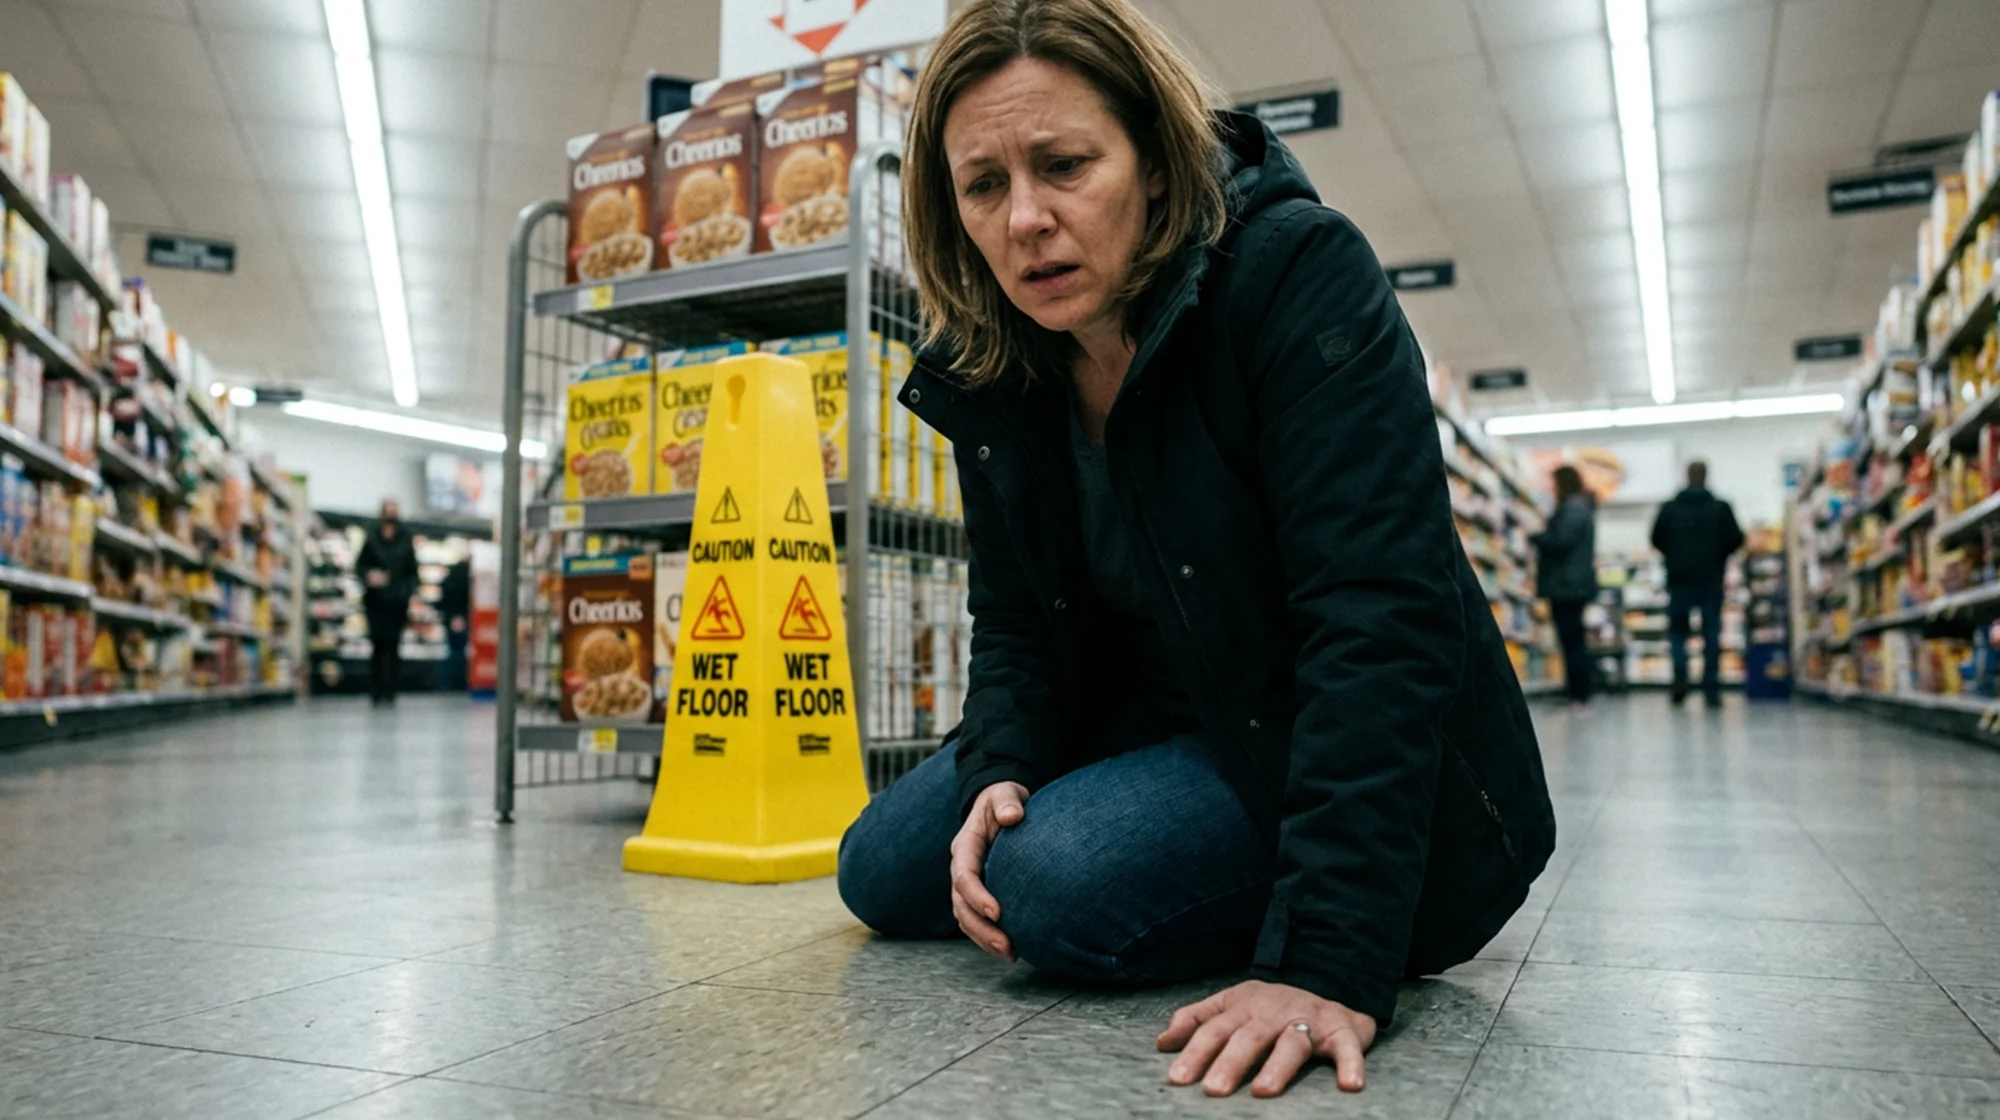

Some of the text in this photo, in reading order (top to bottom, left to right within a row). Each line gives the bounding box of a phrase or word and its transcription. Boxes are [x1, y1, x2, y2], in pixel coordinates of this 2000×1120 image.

[692, 538, 755, 563] CAUTION
[769, 537, 831, 563] CAUTION
[568, 597, 643, 625] Cheerios
[692, 653, 738, 680] WET
[784, 653, 830, 680] WET
[677, 688, 748, 717] FLOOR
[775, 688, 846, 717] FLOOR
